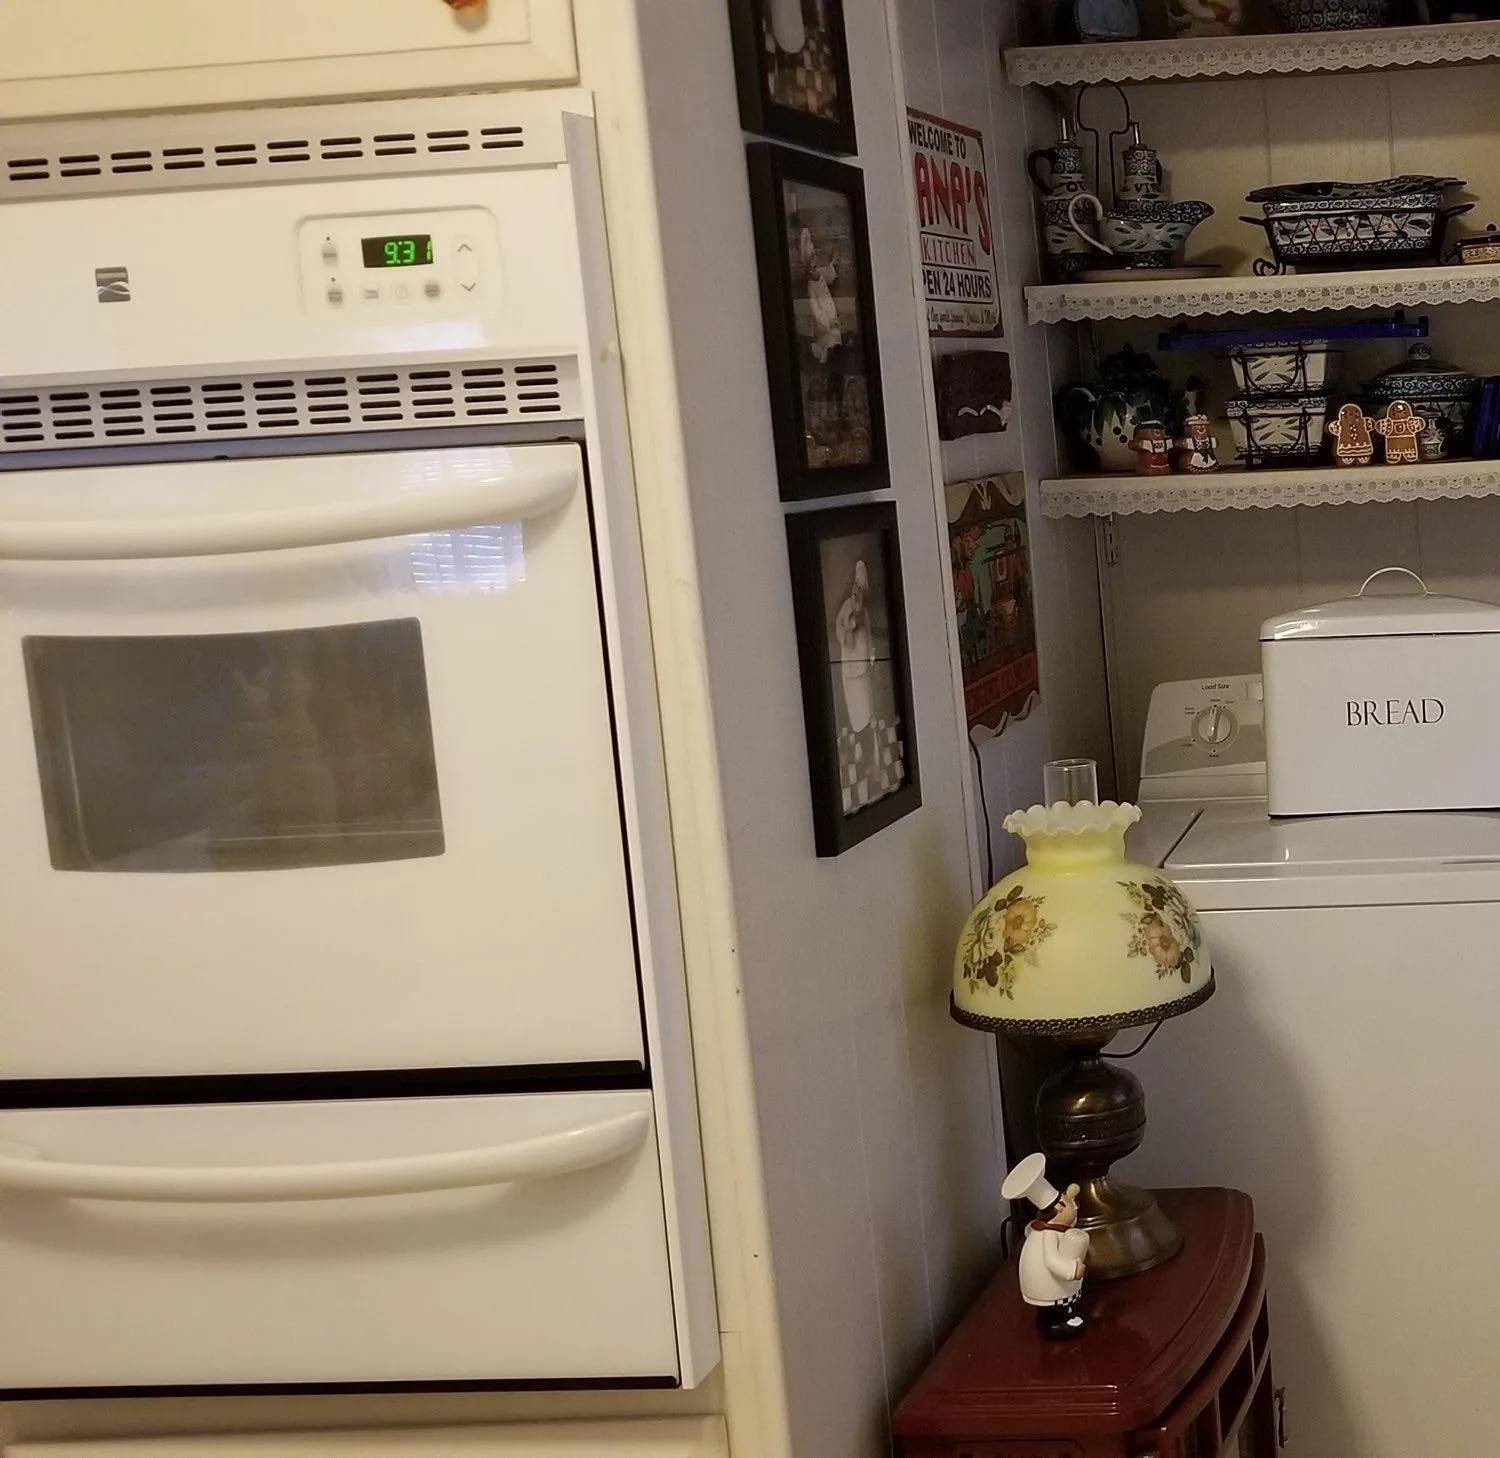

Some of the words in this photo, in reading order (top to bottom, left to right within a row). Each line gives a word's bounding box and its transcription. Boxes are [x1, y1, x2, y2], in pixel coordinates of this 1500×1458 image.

[907, 119, 953, 155] WELCOME
[955, 134, 966, 159] TO
[914, 152, 991, 256] ANA'S
[923, 236, 977, 266] KITCHEN
[943, 271, 956, 296] 24
[957, 272, 992, 298] HOURS
[1346, 698, 1446, 727] BREAD
